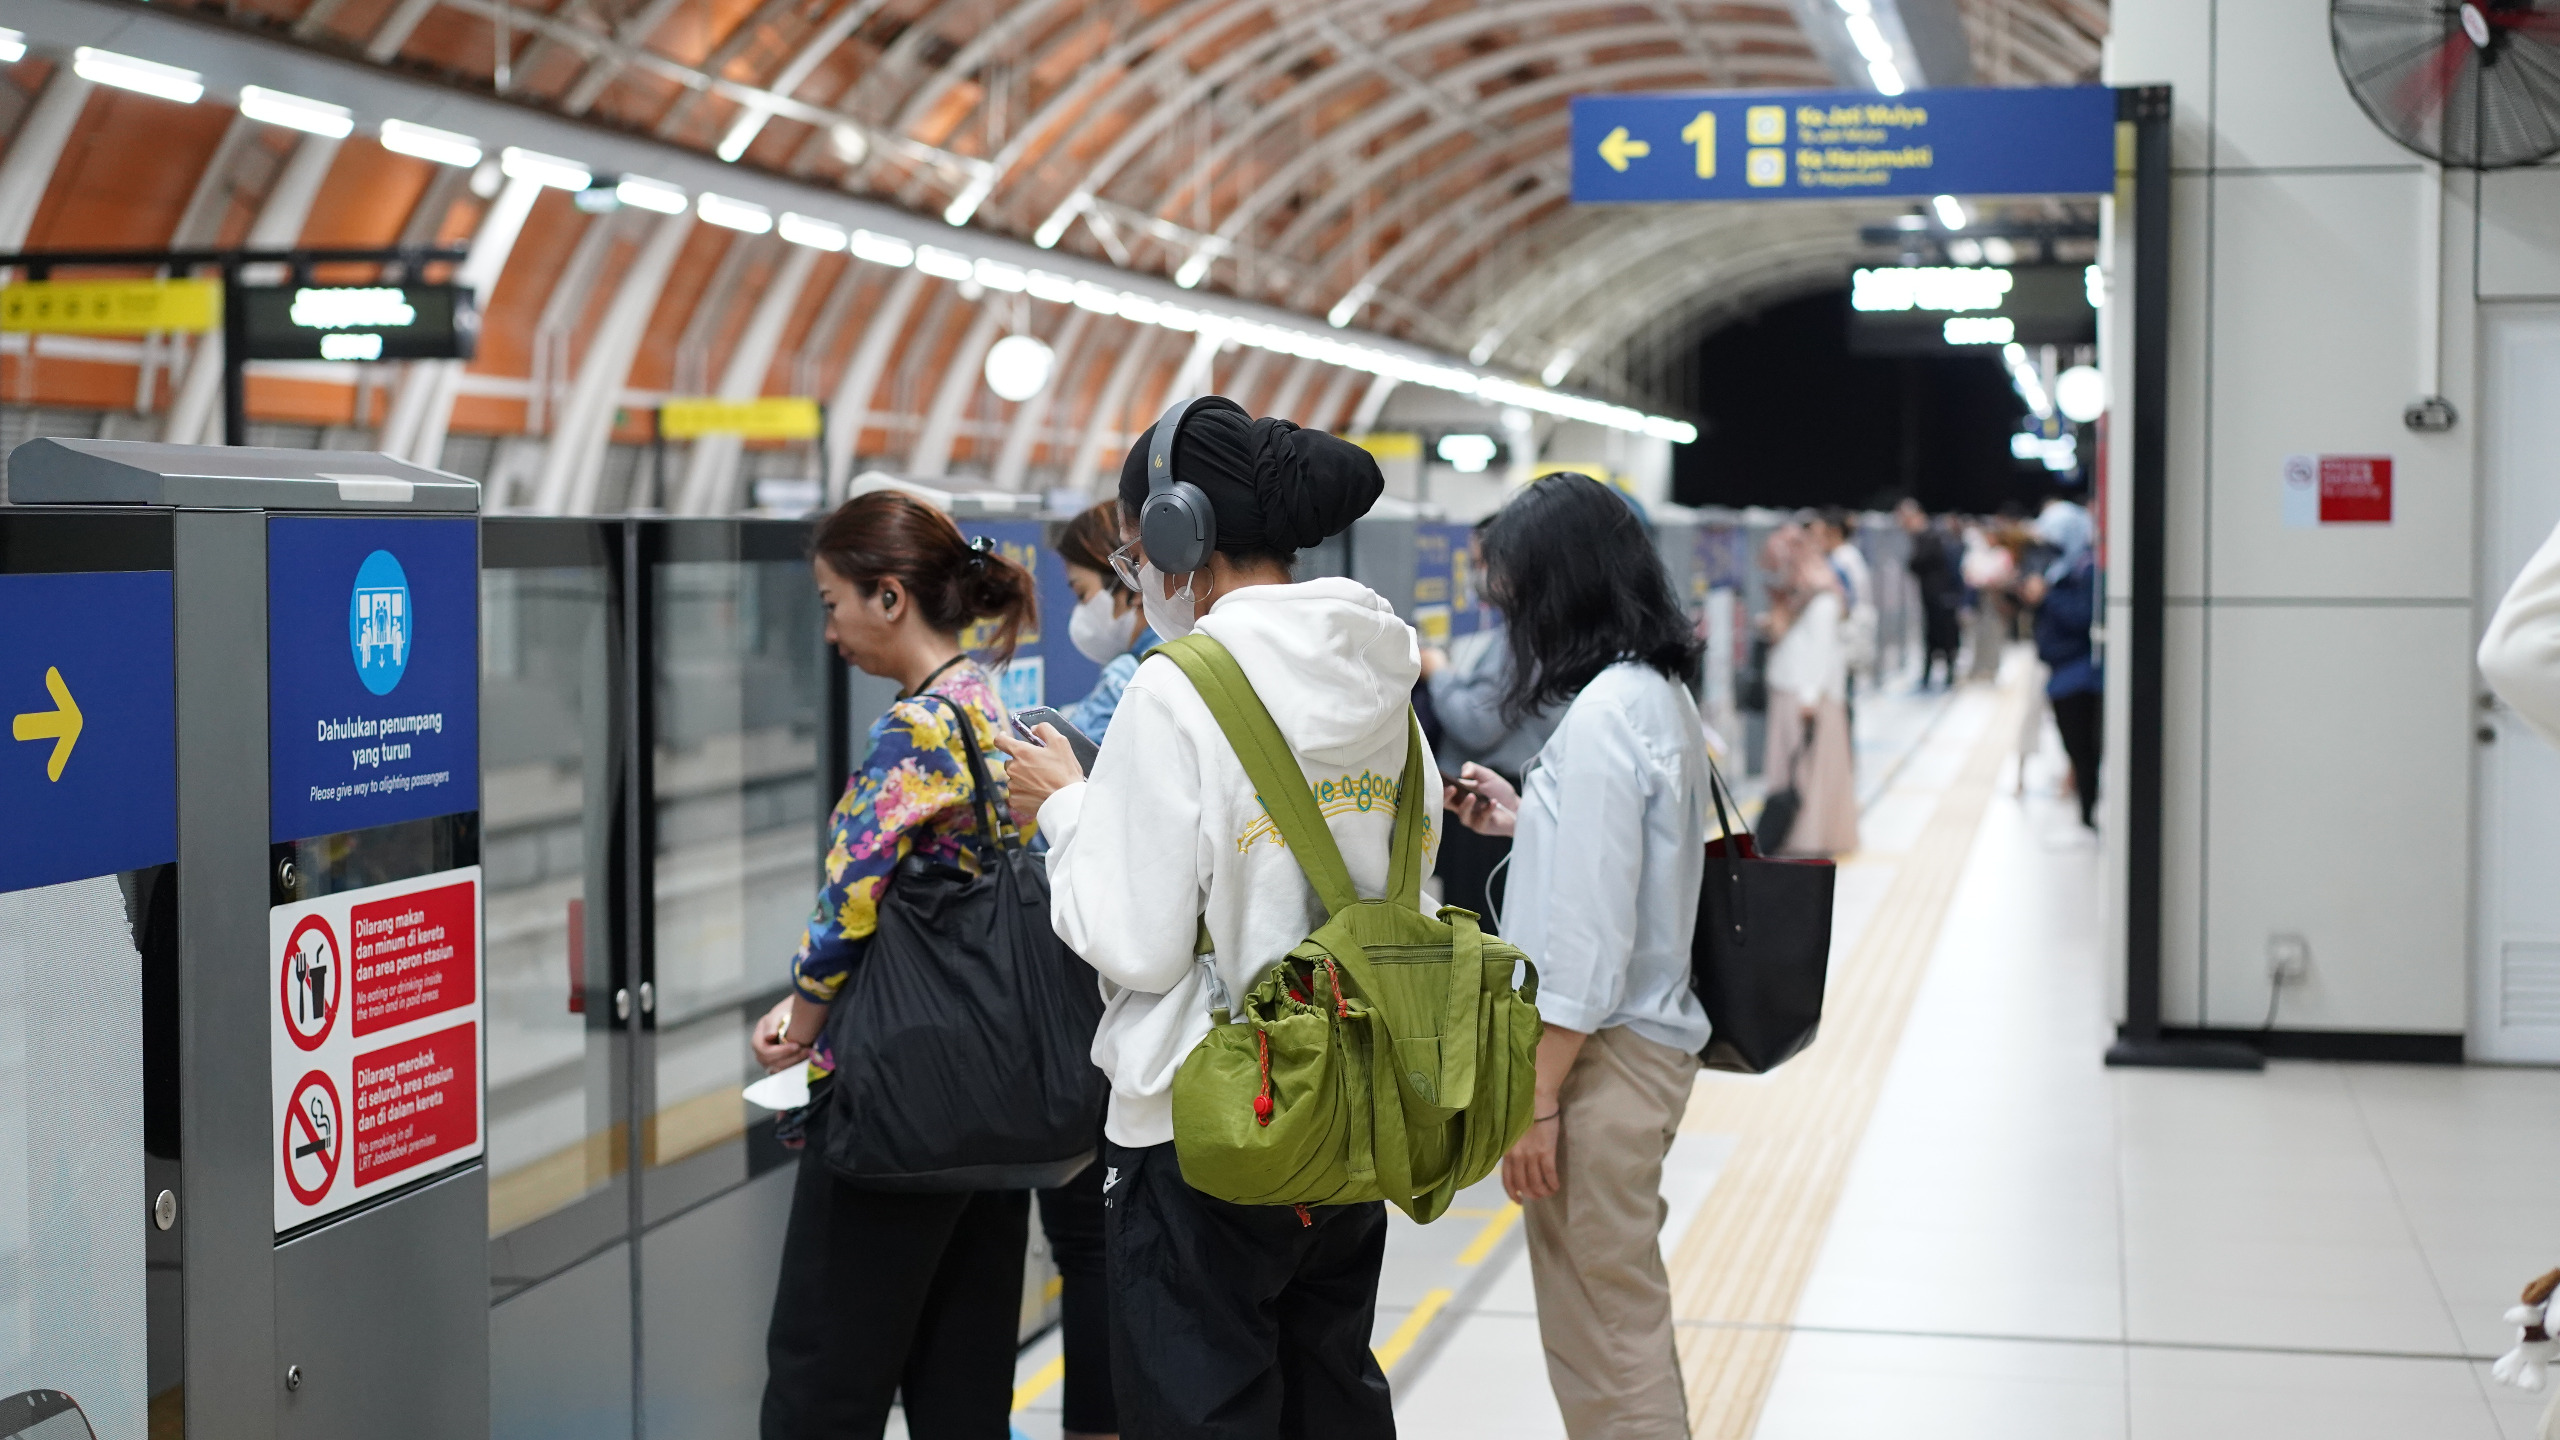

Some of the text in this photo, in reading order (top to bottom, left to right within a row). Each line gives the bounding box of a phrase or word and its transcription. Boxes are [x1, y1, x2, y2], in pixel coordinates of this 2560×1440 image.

[1681, 110, 1717, 179] 1
[318, 713, 442, 741] Dahulukan penumpang
[352, 743, 411, 770] yang turun
[310, 771, 449, 801] Please give way to alighting passengers
[356, 909, 424, 938] Dilarang makan
[356, 925, 445, 959] dan minum di kereta
[356, 944, 454, 981] dan area peron stasiun
[356, 991, 366, 1005] No
[367, 987, 388, 1002] eating
[389, 985, 396, 996] or
[397, 977, 423, 994] drinking
[356, 1008, 367, 1021] the
[369, 1003, 385, 1017] train
[385, 998, 398, 1013] and
[399, 997, 406, 1009] in
[406, 991, 420, 1009] paid
[358, 1048, 435, 1088] Dilarang merokok
[358, 1067, 454, 1110] di seluruh area stasiun
[358, 1091, 444, 1132] dan di dalam kereta
[358, 1142, 369, 1155] No
[369, 1132, 396, 1151] smoking
[358, 1154, 372, 1171] LRT
